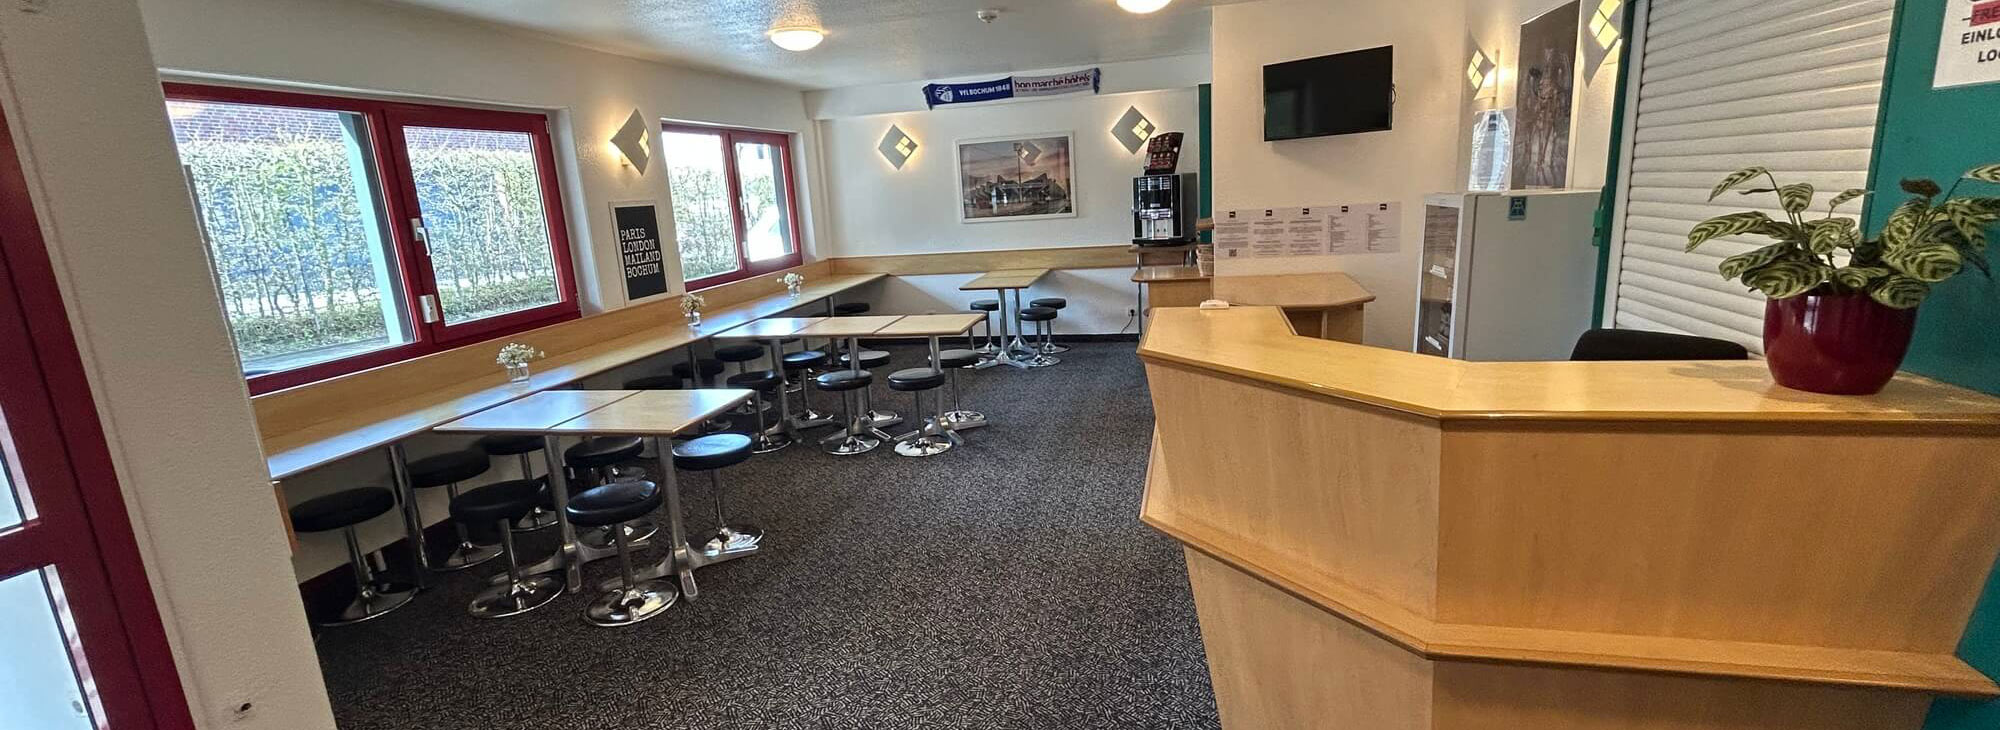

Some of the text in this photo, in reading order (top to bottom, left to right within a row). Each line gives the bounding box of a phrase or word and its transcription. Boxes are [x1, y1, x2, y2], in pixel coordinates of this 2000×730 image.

[1977, 49, 2000, 63] LO
[969, 86, 995, 96] BOCHUM
[995, 83, 1010, 92] 1848
[620, 228, 646, 241] PARIS
[622, 239, 656, 253] LONDON
[624, 250, 661, 266] MAILAND
[626, 262, 660, 278] BOCHUM
